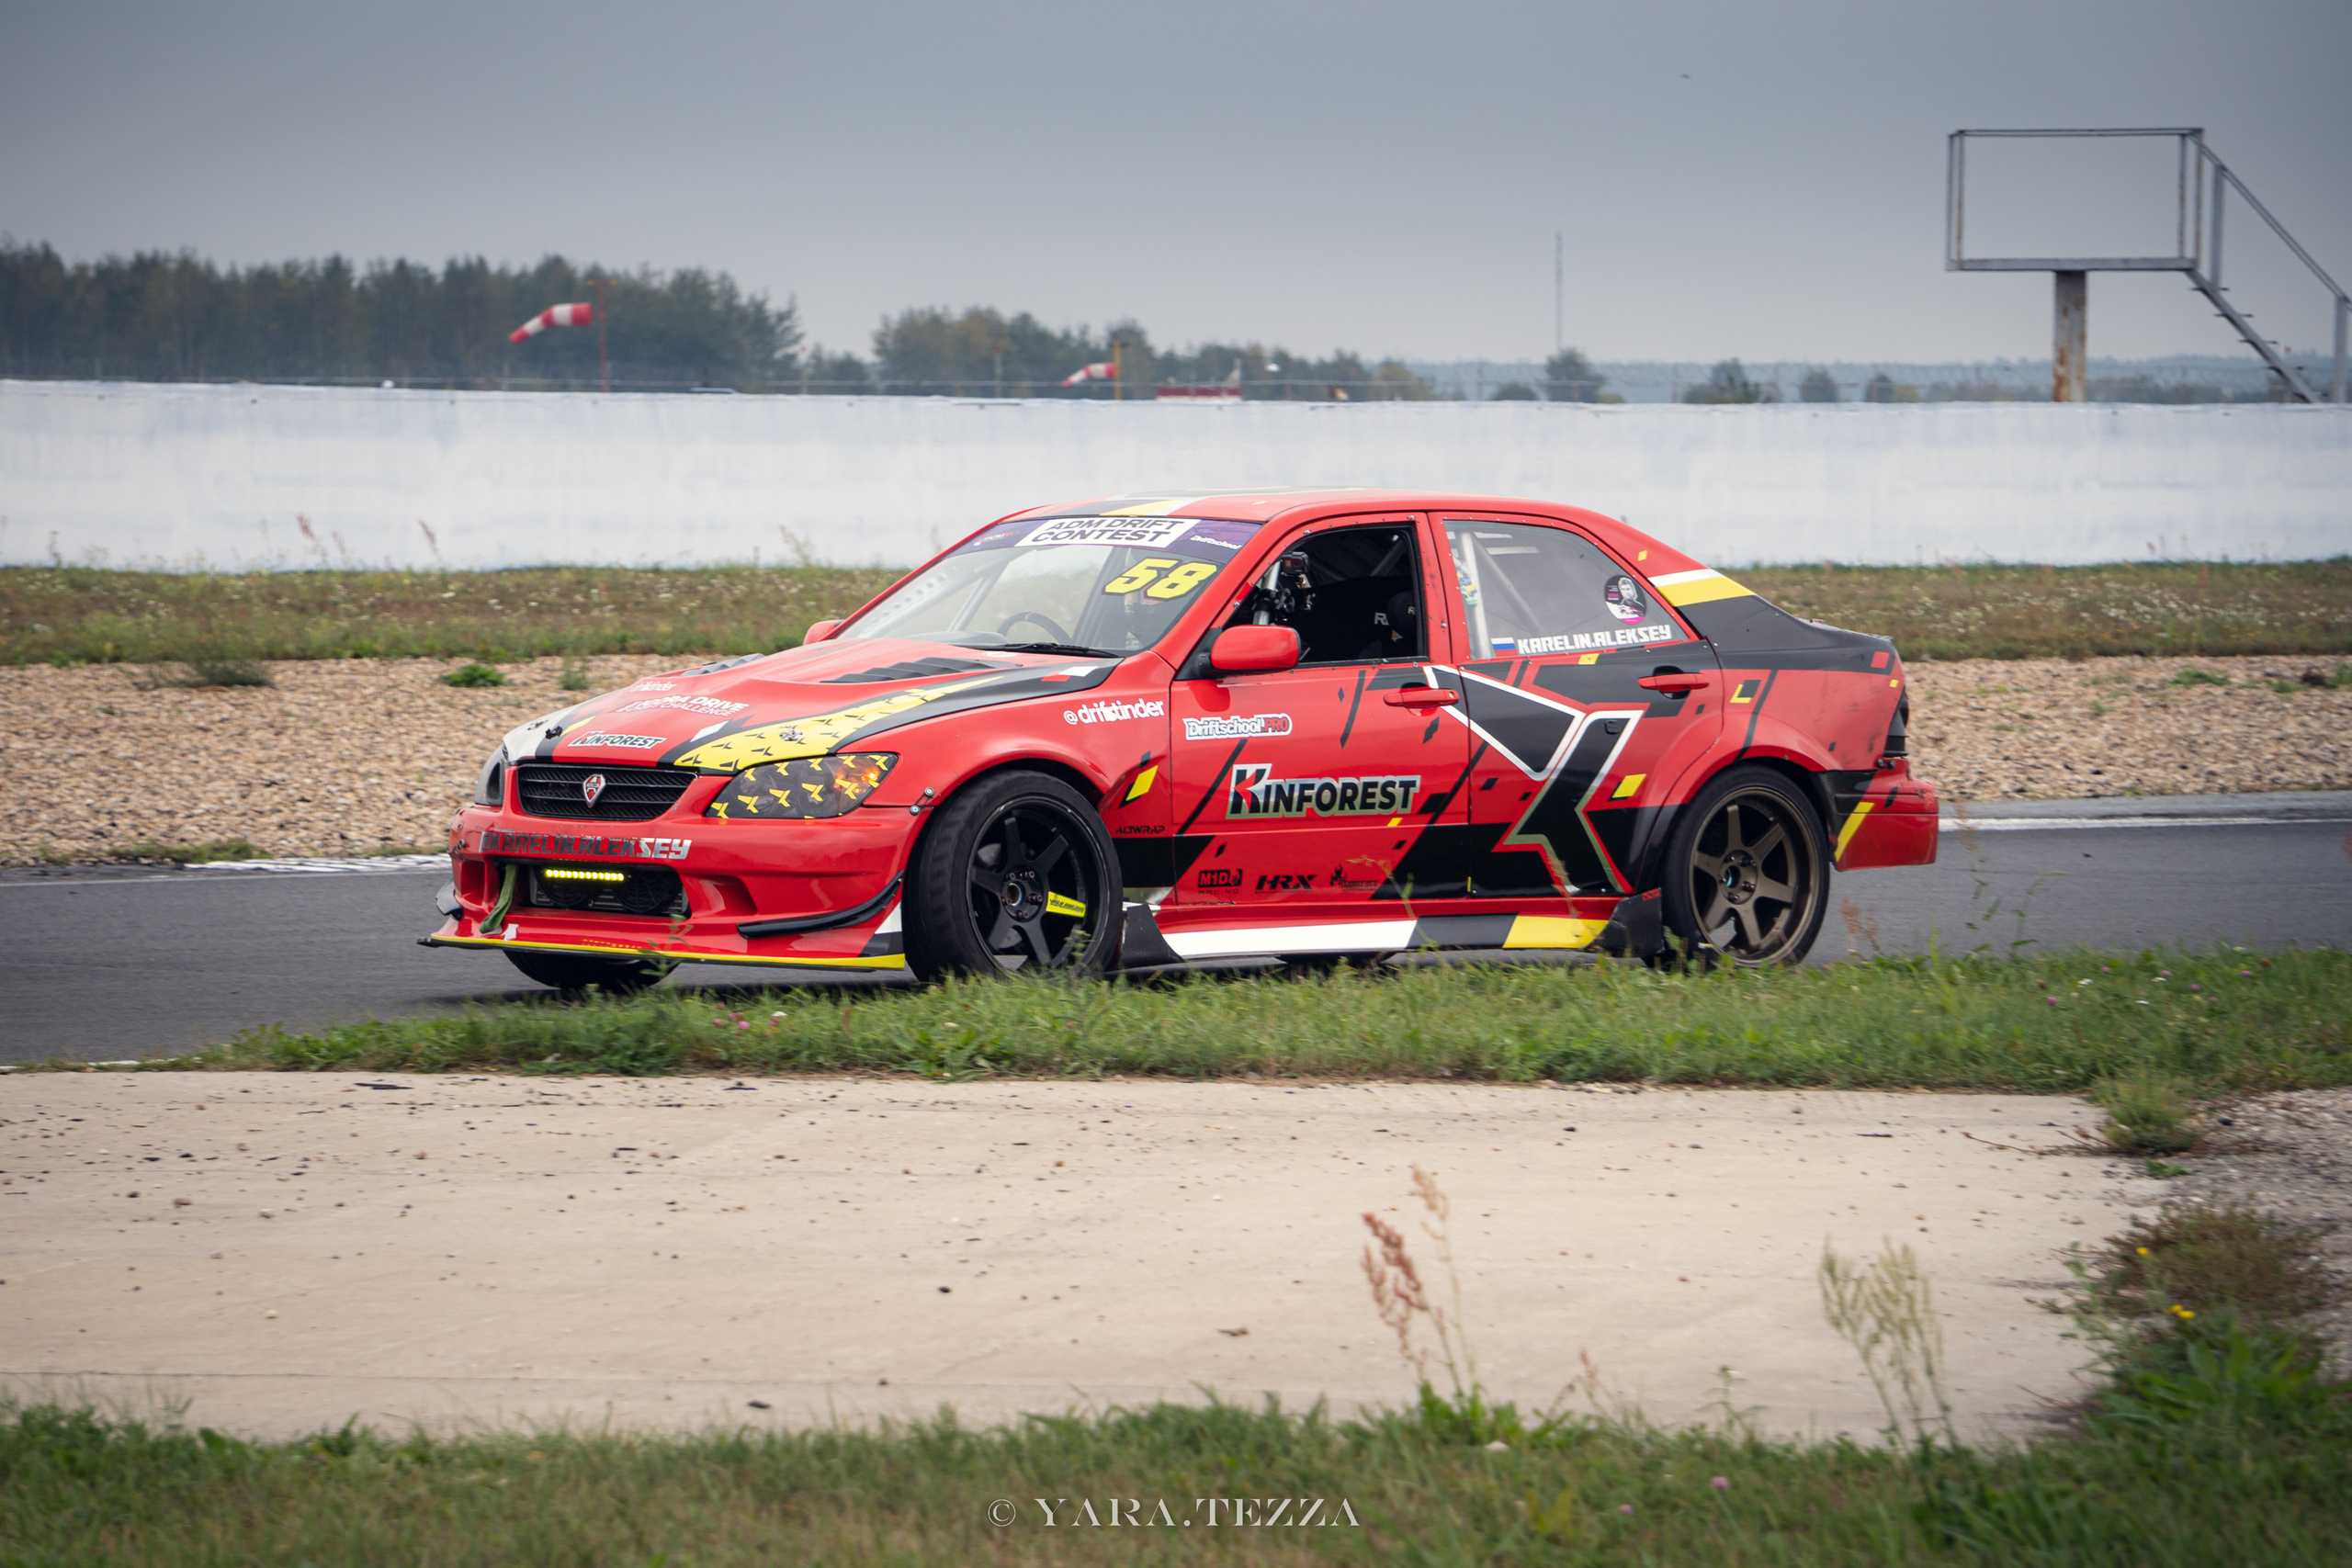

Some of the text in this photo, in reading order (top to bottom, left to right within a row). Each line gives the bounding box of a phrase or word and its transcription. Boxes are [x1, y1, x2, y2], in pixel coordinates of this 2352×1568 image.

[1045, 518, 1184, 531] ADM DRIFT
[1032, 529, 1170, 544] CONTEST
[1104, 558, 1218, 600] 58
[1517, 624, 1673, 655] KARELIN.ALEKSEY
[660, 702, 732, 716] CHALLENGE
[689, 695, 750, 712] DRIVE
[571, 731, 664, 749] KINFOREST
[1232, 766, 1419, 817] KINFOREST
[1255, 874, 1317, 891] HRX
